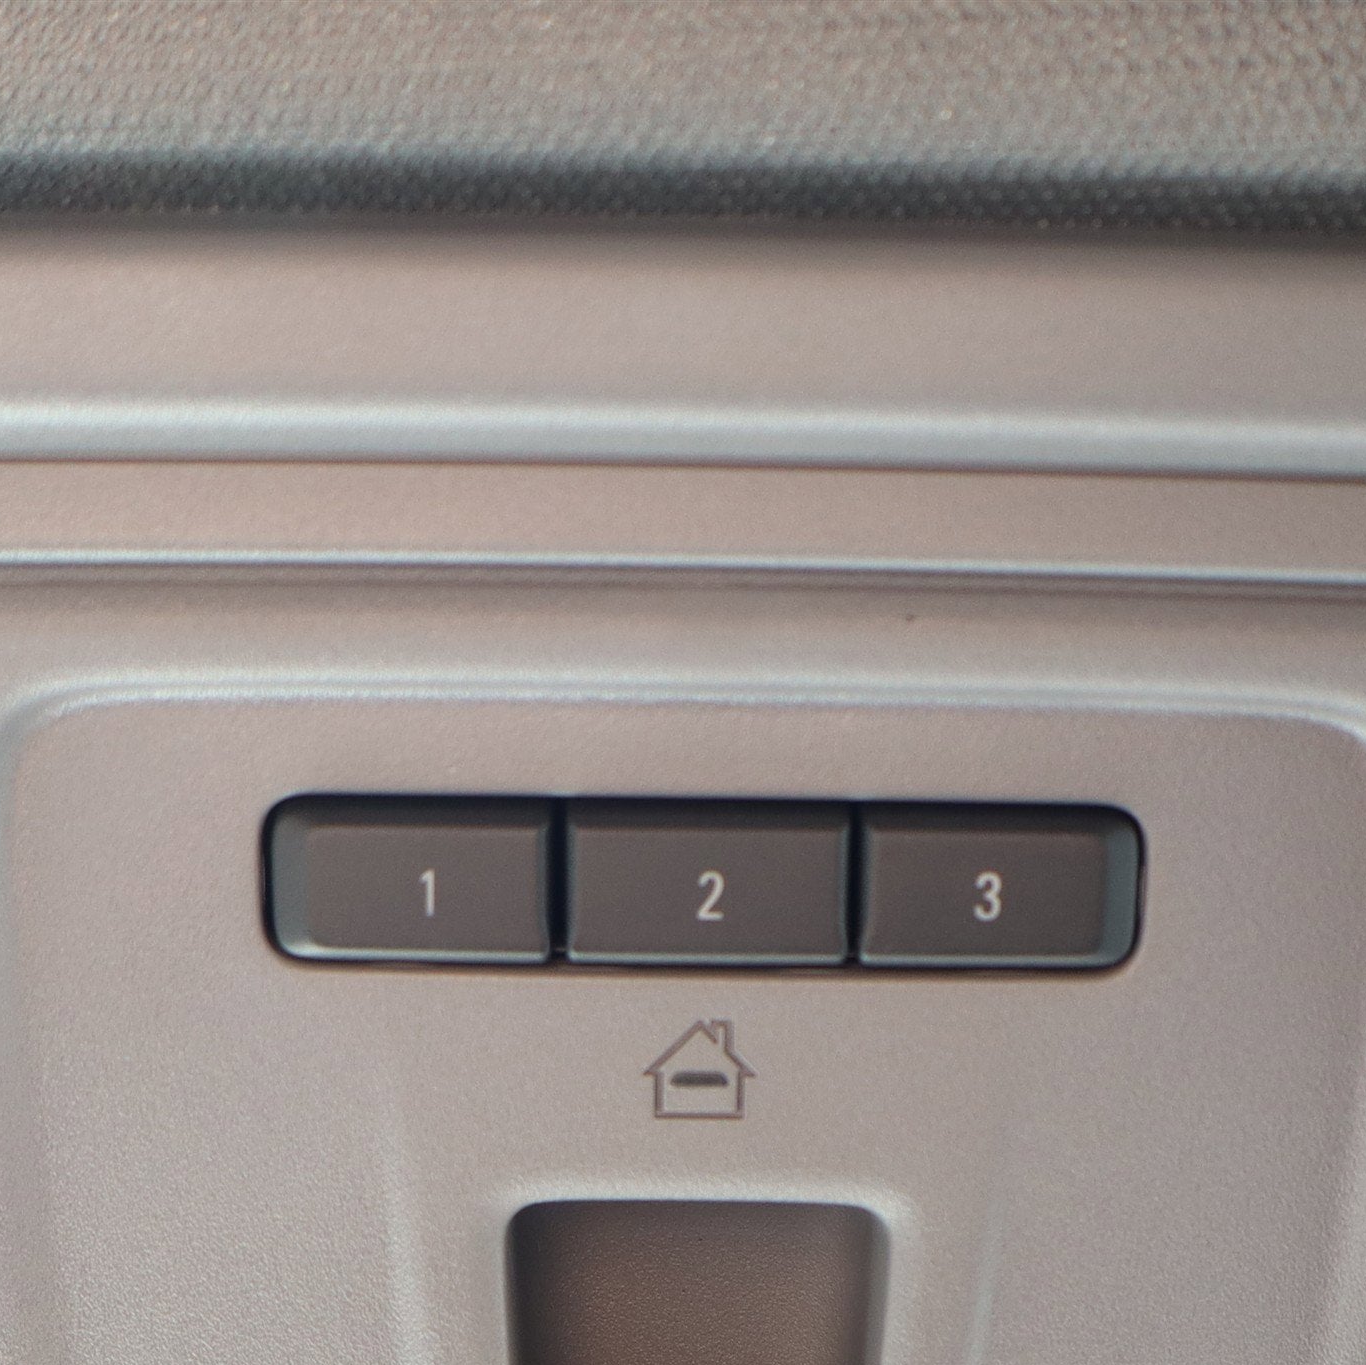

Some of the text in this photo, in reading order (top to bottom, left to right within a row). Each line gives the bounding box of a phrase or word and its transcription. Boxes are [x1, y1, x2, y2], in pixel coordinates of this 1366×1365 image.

[419, 869, 436, 917] 1
[696, 870, 725, 921] 2
[973, 872, 1003, 922] 3
